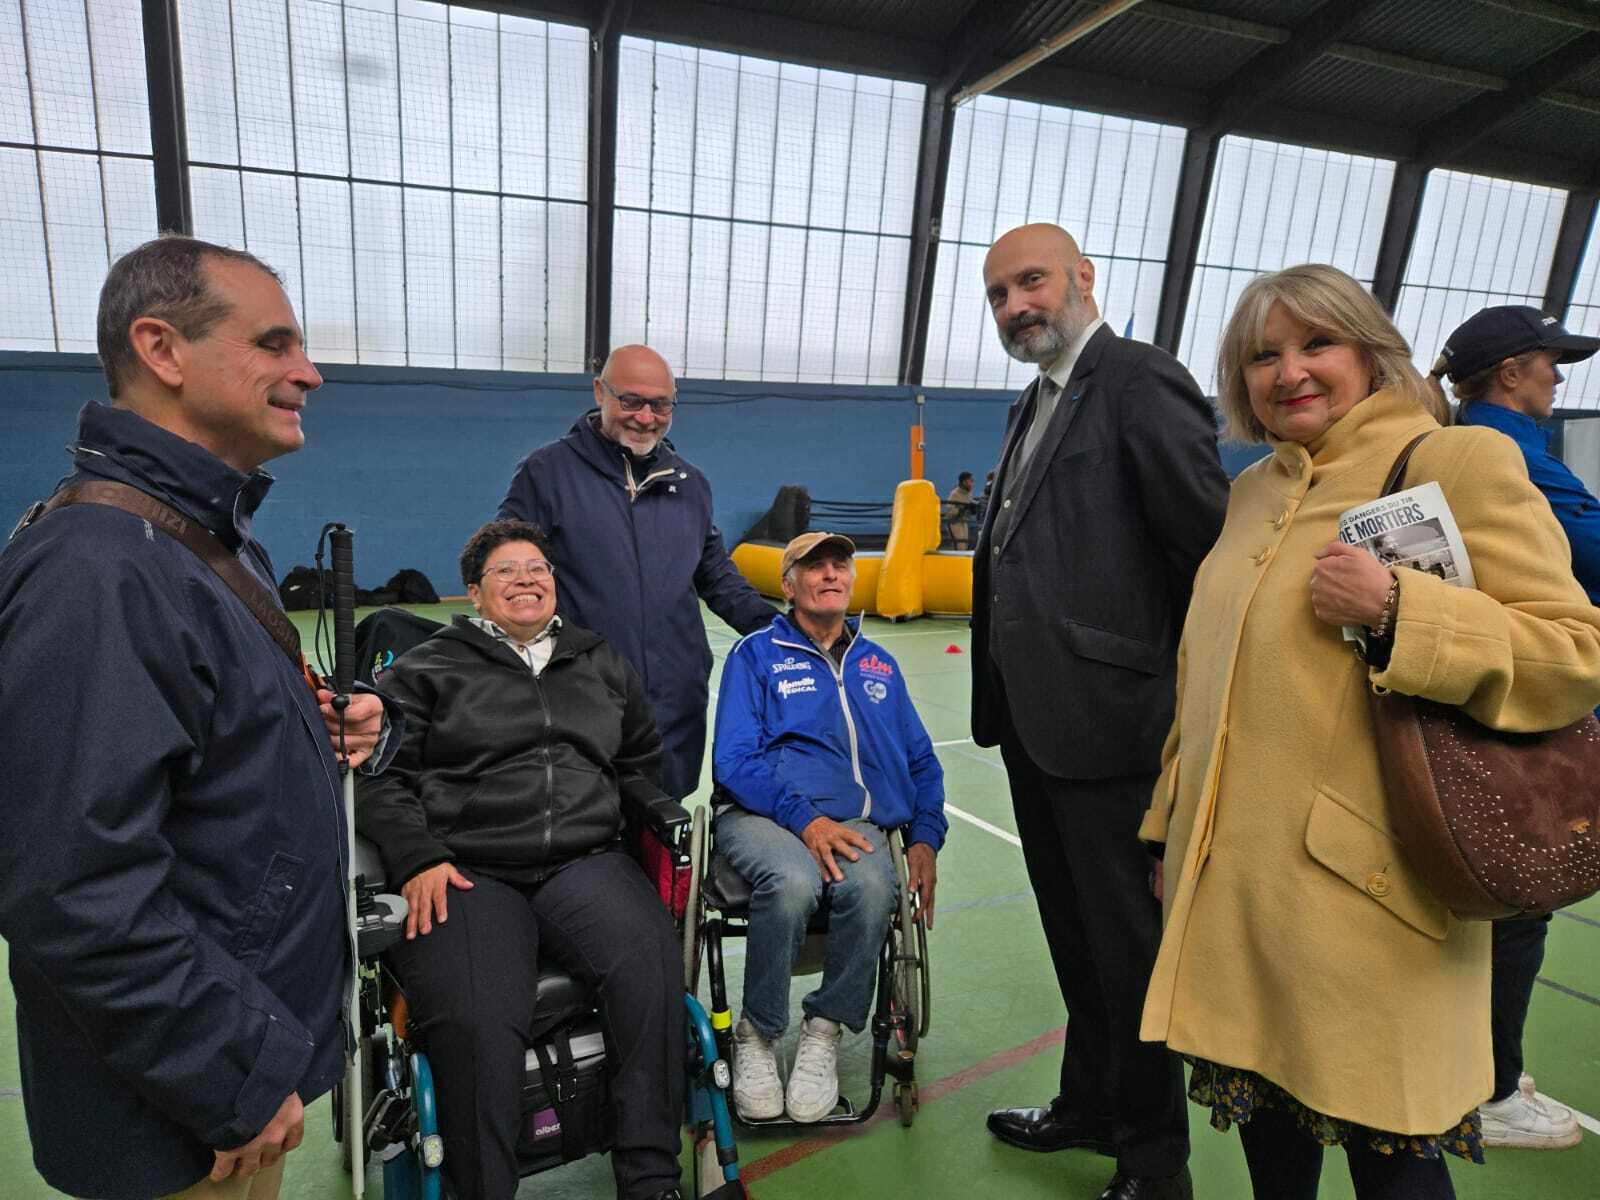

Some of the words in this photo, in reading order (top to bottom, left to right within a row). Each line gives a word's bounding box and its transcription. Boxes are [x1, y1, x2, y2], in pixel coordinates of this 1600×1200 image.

[1348, 504, 1387, 523] DANGERS
[1388, 500, 1400, 509] DU
[1354, 503, 1425, 540] MORTIERS
[535, 1122, 561, 1136] alber
